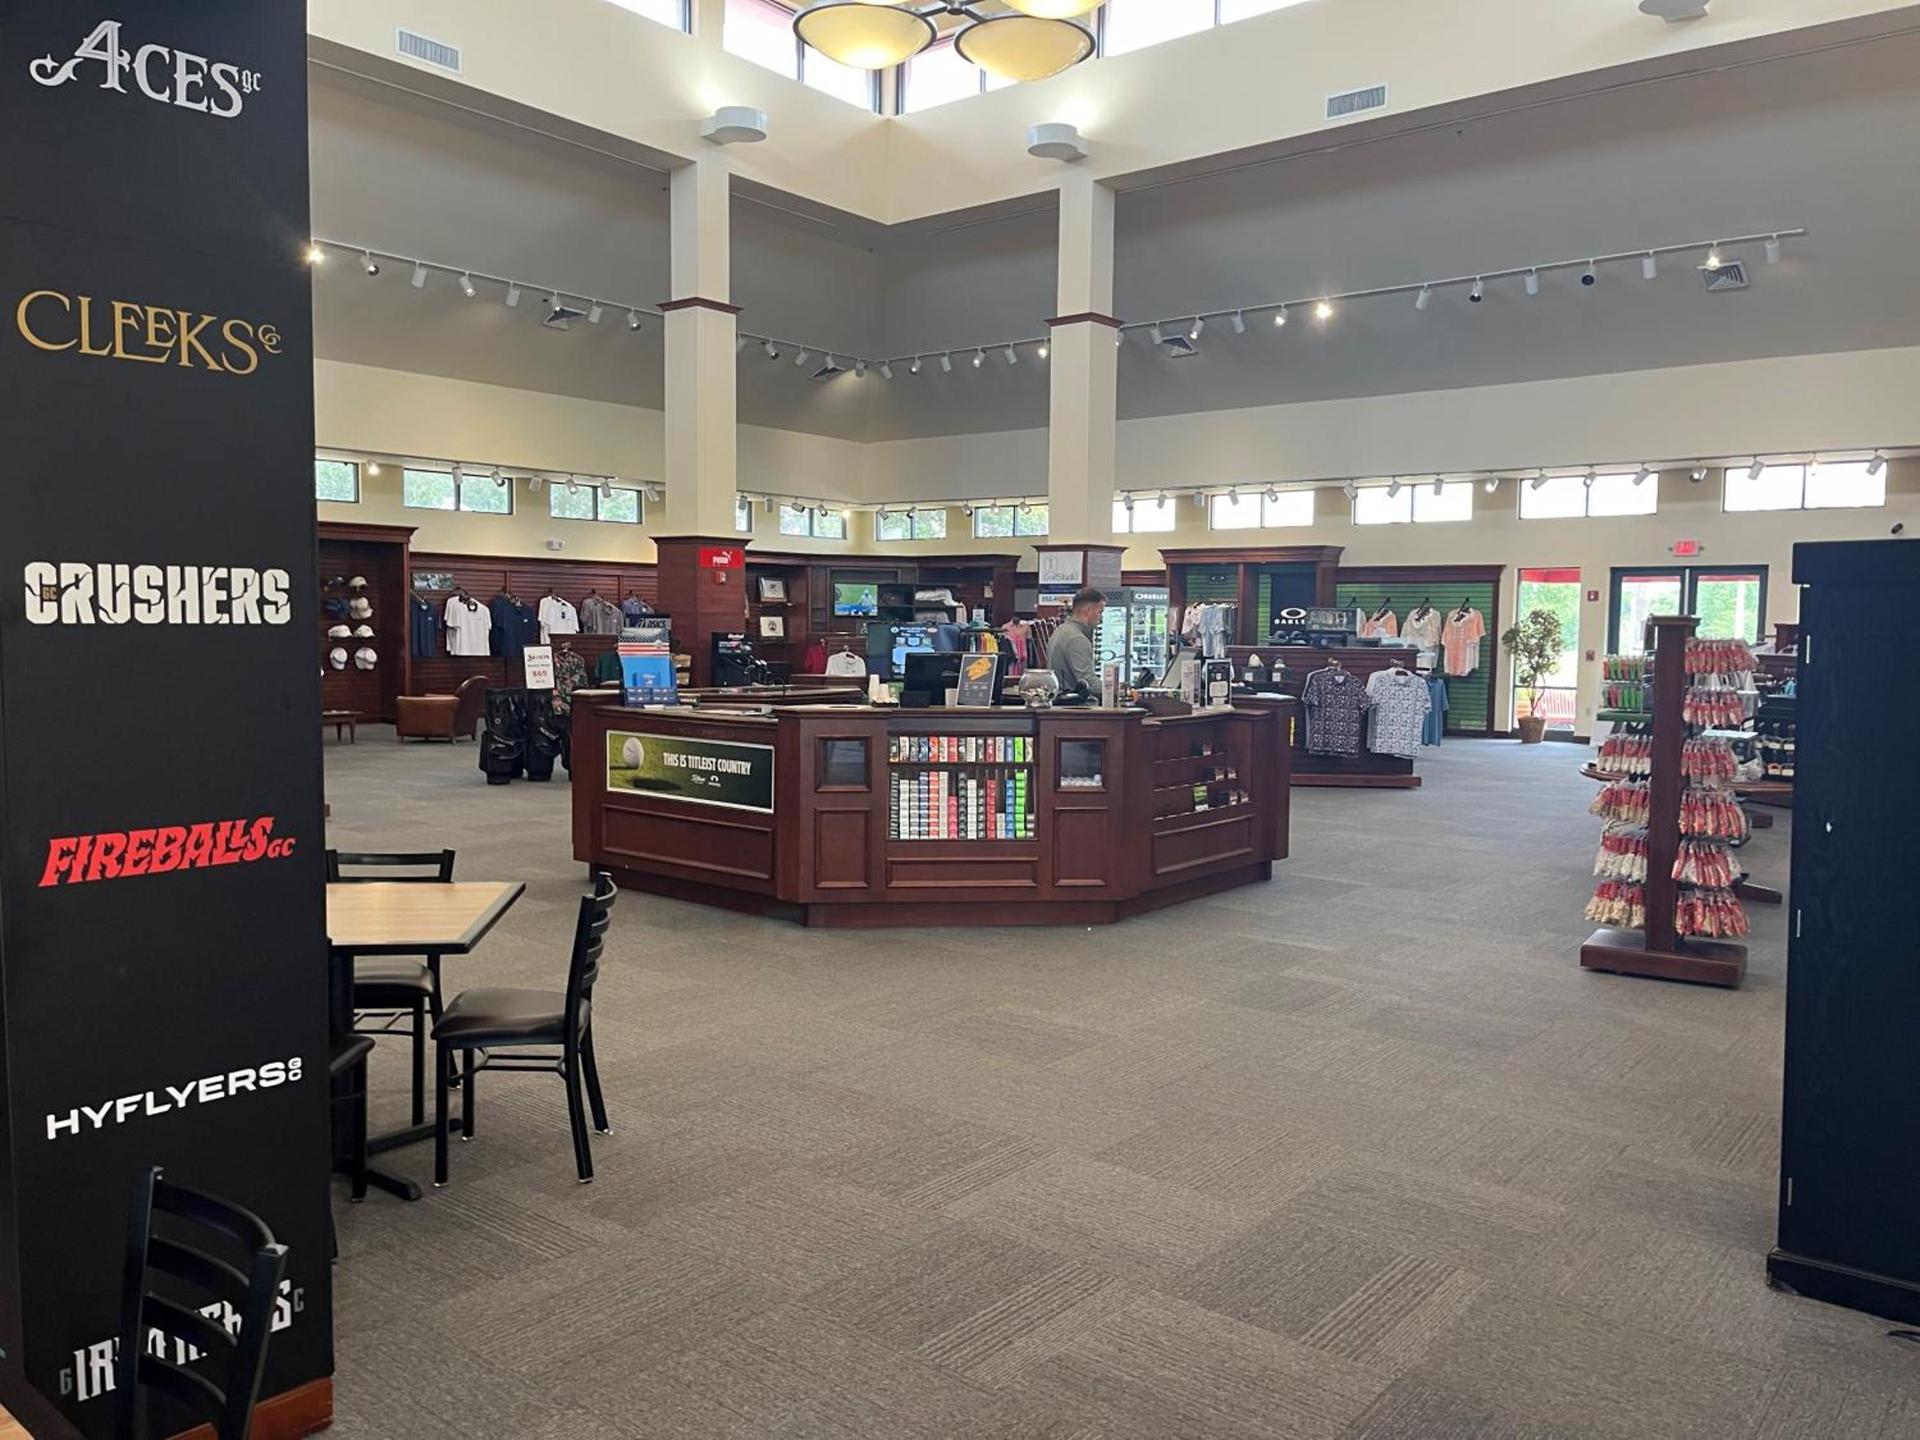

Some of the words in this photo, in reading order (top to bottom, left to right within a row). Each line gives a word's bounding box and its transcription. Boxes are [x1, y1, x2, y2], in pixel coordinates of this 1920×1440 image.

[29, 20, 243, 118] ACES
[16, 290, 258, 375] CLEEKS
[24, 561, 292, 625] CRUSHERS
[663, 752, 679, 767] THIS
[680, 754, 687, 768] IS
[688, 755, 717, 771] TITLEIST
[717, 758, 752, 775] COUNTRY
[38, 816, 274, 887] FIREBALLS
[267, 838, 296, 858] GC
[46, 1062, 286, 1140] HYFLYERS
